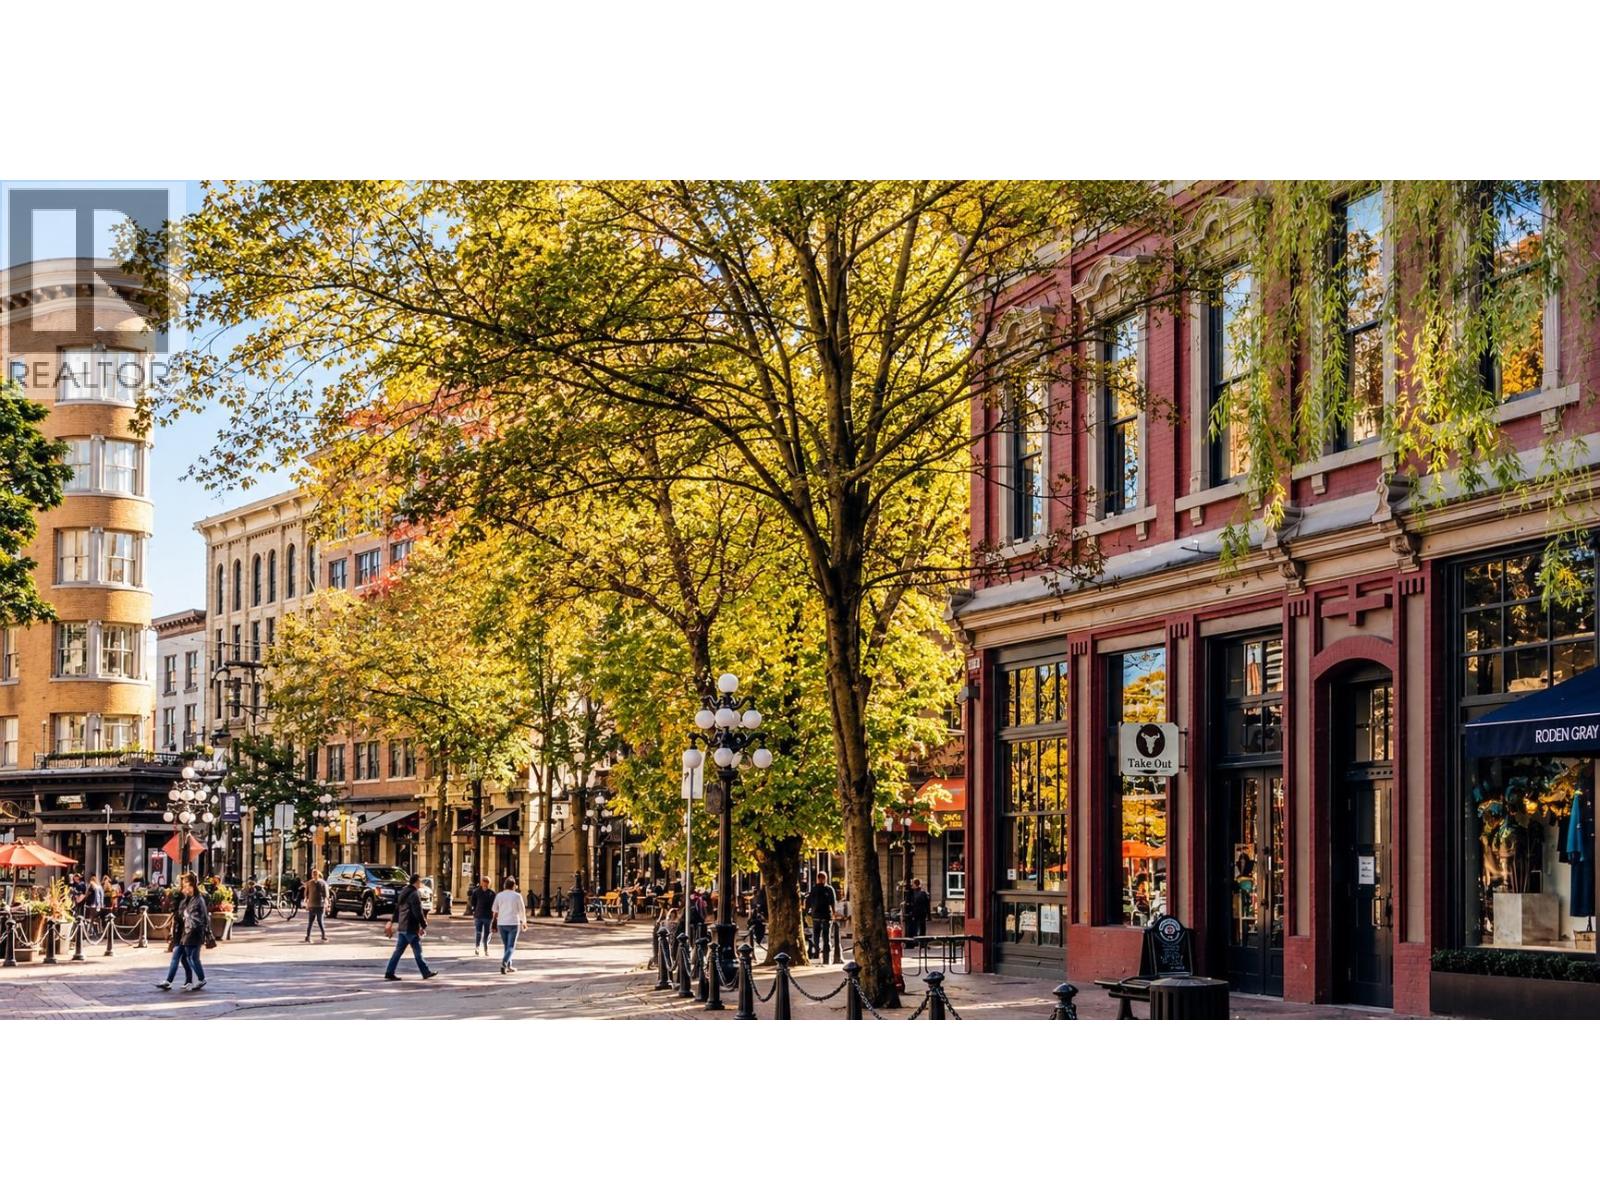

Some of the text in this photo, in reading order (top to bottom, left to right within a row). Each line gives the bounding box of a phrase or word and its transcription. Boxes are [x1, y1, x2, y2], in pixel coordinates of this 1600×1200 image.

[1535, 724, 1599, 743] RODEN GRAY
[1128, 758, 1172, 769] Take Out
